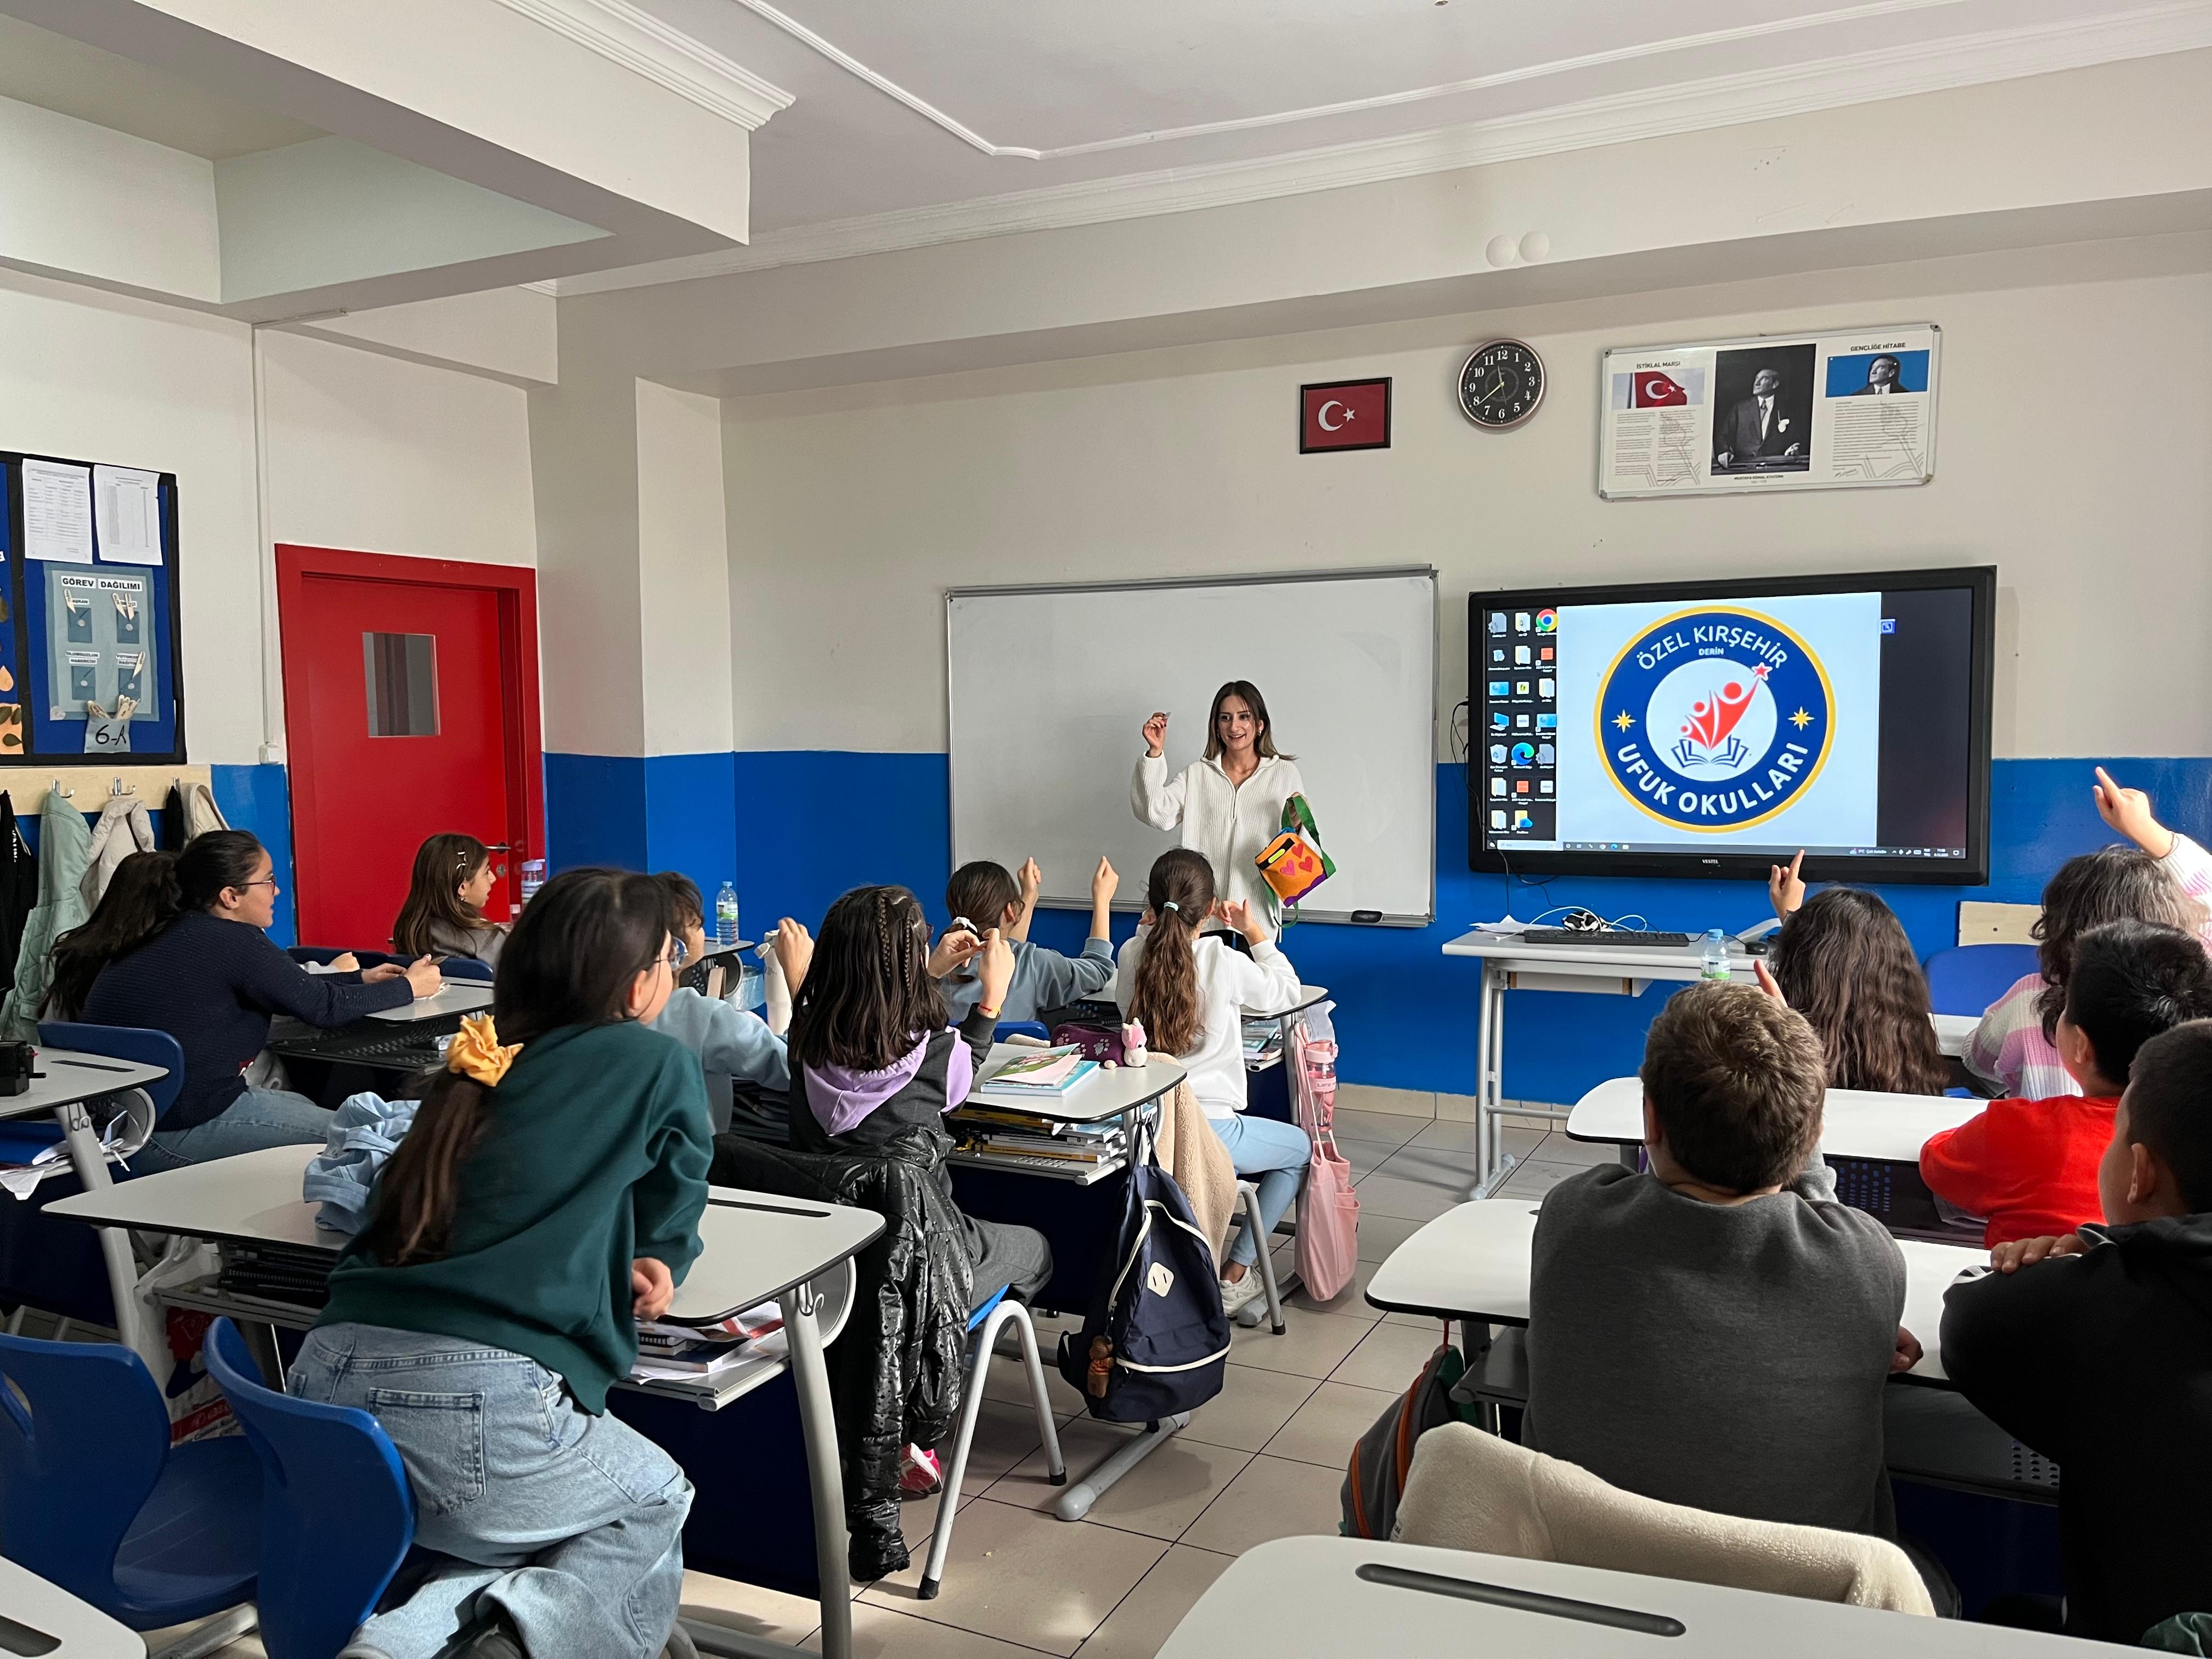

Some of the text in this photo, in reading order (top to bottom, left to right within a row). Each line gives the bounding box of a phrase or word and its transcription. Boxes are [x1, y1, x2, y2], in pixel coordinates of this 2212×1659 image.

[1497, 350, 1508, 360] 12
[1515, 353, 1519, 362] 1
[1484, 356, 1494, 365] 11
[1525, 362, 1531, 371] 2
[1474, 367, 1484, 377] 10
[1528, 376, 1535, 386] 3
[1469, 382, 1476, 392] 9
[1525, 390, 1531, 400] 4
[1473, 396, 1480, 406] 8
[1484, 405, 1491, 415] 7
[1514, 402, 1520, 413] 5
[1498, 409, 1505, 419] 6
[63, 577, 140, 590] GÖREV DAĞILIMI
[1637, 625, 1788, 670] ÖZEL KIRŞEHİR
[1698, 646, 1724, 656] DERİN
[95, 724, 126, 746] 6-A
[1618, 742, 1808, 816] UFUK OKULLARI
